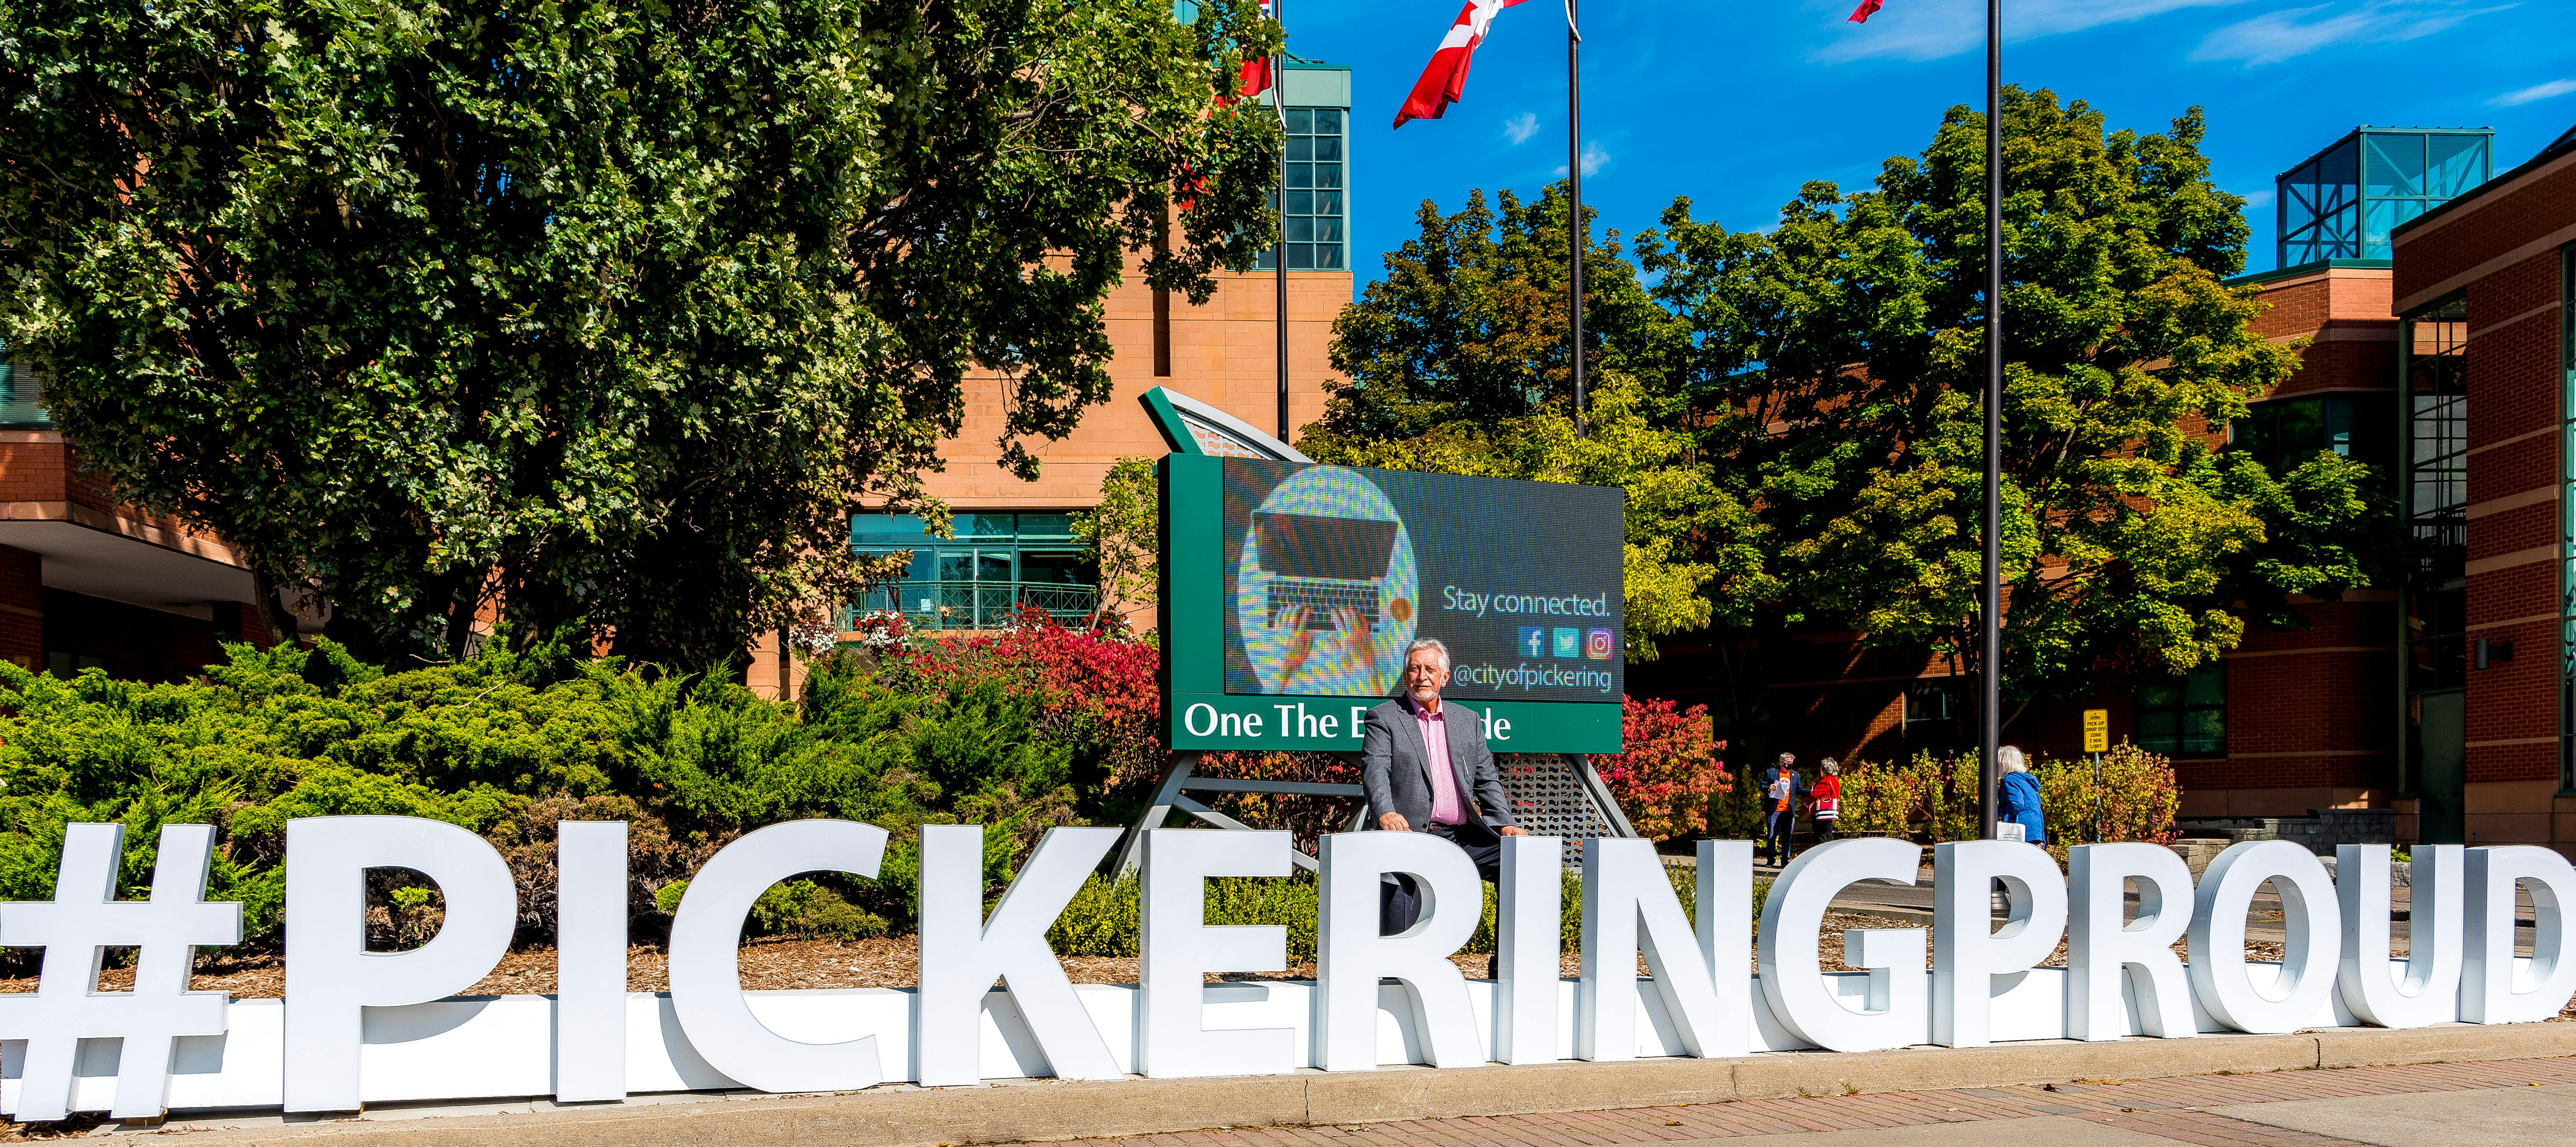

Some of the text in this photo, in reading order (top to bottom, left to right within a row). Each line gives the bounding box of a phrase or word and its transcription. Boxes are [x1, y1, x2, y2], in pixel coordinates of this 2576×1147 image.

[1444, 585, 1610, 618] Stay connected.
[1454, 663, 1612, 693] @cityofpickering
[1184, 702, 1263, 737] One
[1273, 702, 1339, 738] The
[0, 815, 2576, 1121] #PICKERINGPROUD
